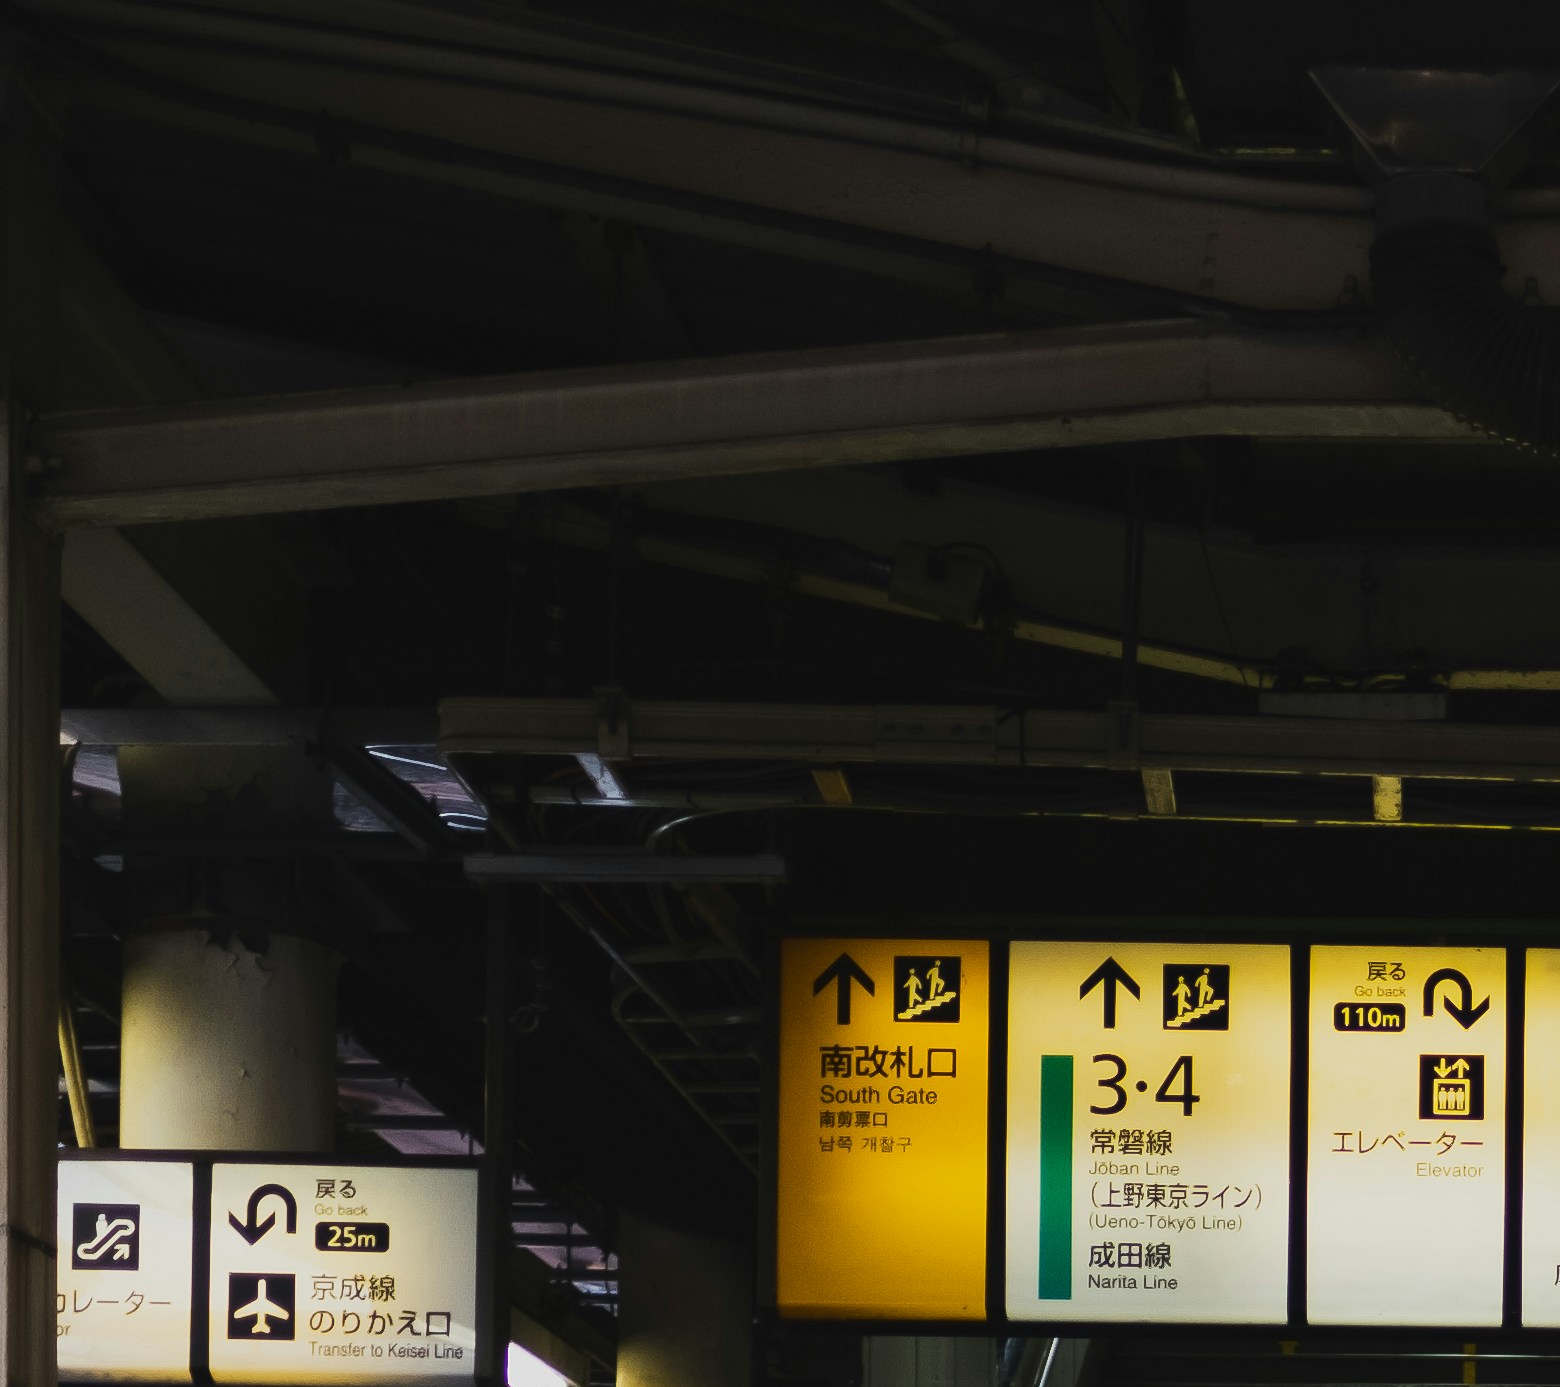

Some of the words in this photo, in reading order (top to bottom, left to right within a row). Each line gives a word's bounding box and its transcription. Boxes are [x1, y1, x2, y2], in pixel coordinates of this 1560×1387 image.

[1368, 961, 1406, 981] 戻る
[1354, 986, 1374, 998] Go
[1376, 986, 1406, 998] back
[1340, 1006, 1400, 1029] 110m
[820, 1044, 956, 1078] 南改札口
[820, 1085, 880, 1104] South
[888, 1085, 938, 1104] Gate
[1090, 1128, 1173, 1156] 常磐線
[1332, 1130, 1484, 1156] エレベーター
[1145, 1161, 1180, 1176] Line
[1416, 1163, 1484, 1178] Elevator
[314, 1178, 356, 1199] 戻る
[1091, 1181, 1262, 1210] (上野東京ライン)
[314, 1203, 334, 1217] Go
[337, 1203, 367, 1217] back
[1202, 1213, 1242, 1231] Line)
[327, 1226, 377, 1248] 25m
[1089, 1241, 1172, 1268] 成田線
[310, 1273, 396, 1302] 京成線
[1088, 1274, 1138, 1289] Narita
[1143, 1274, 1178, 1289] Line
[309, 1309, 452, 1338] のりかえ口
[309, 1341, 365, 1358] Transfer
[370, 1342, 383, 1358] to
[387, 1342, 429, 1359] Keisei
[433, 1343, 464, 1360] Line
